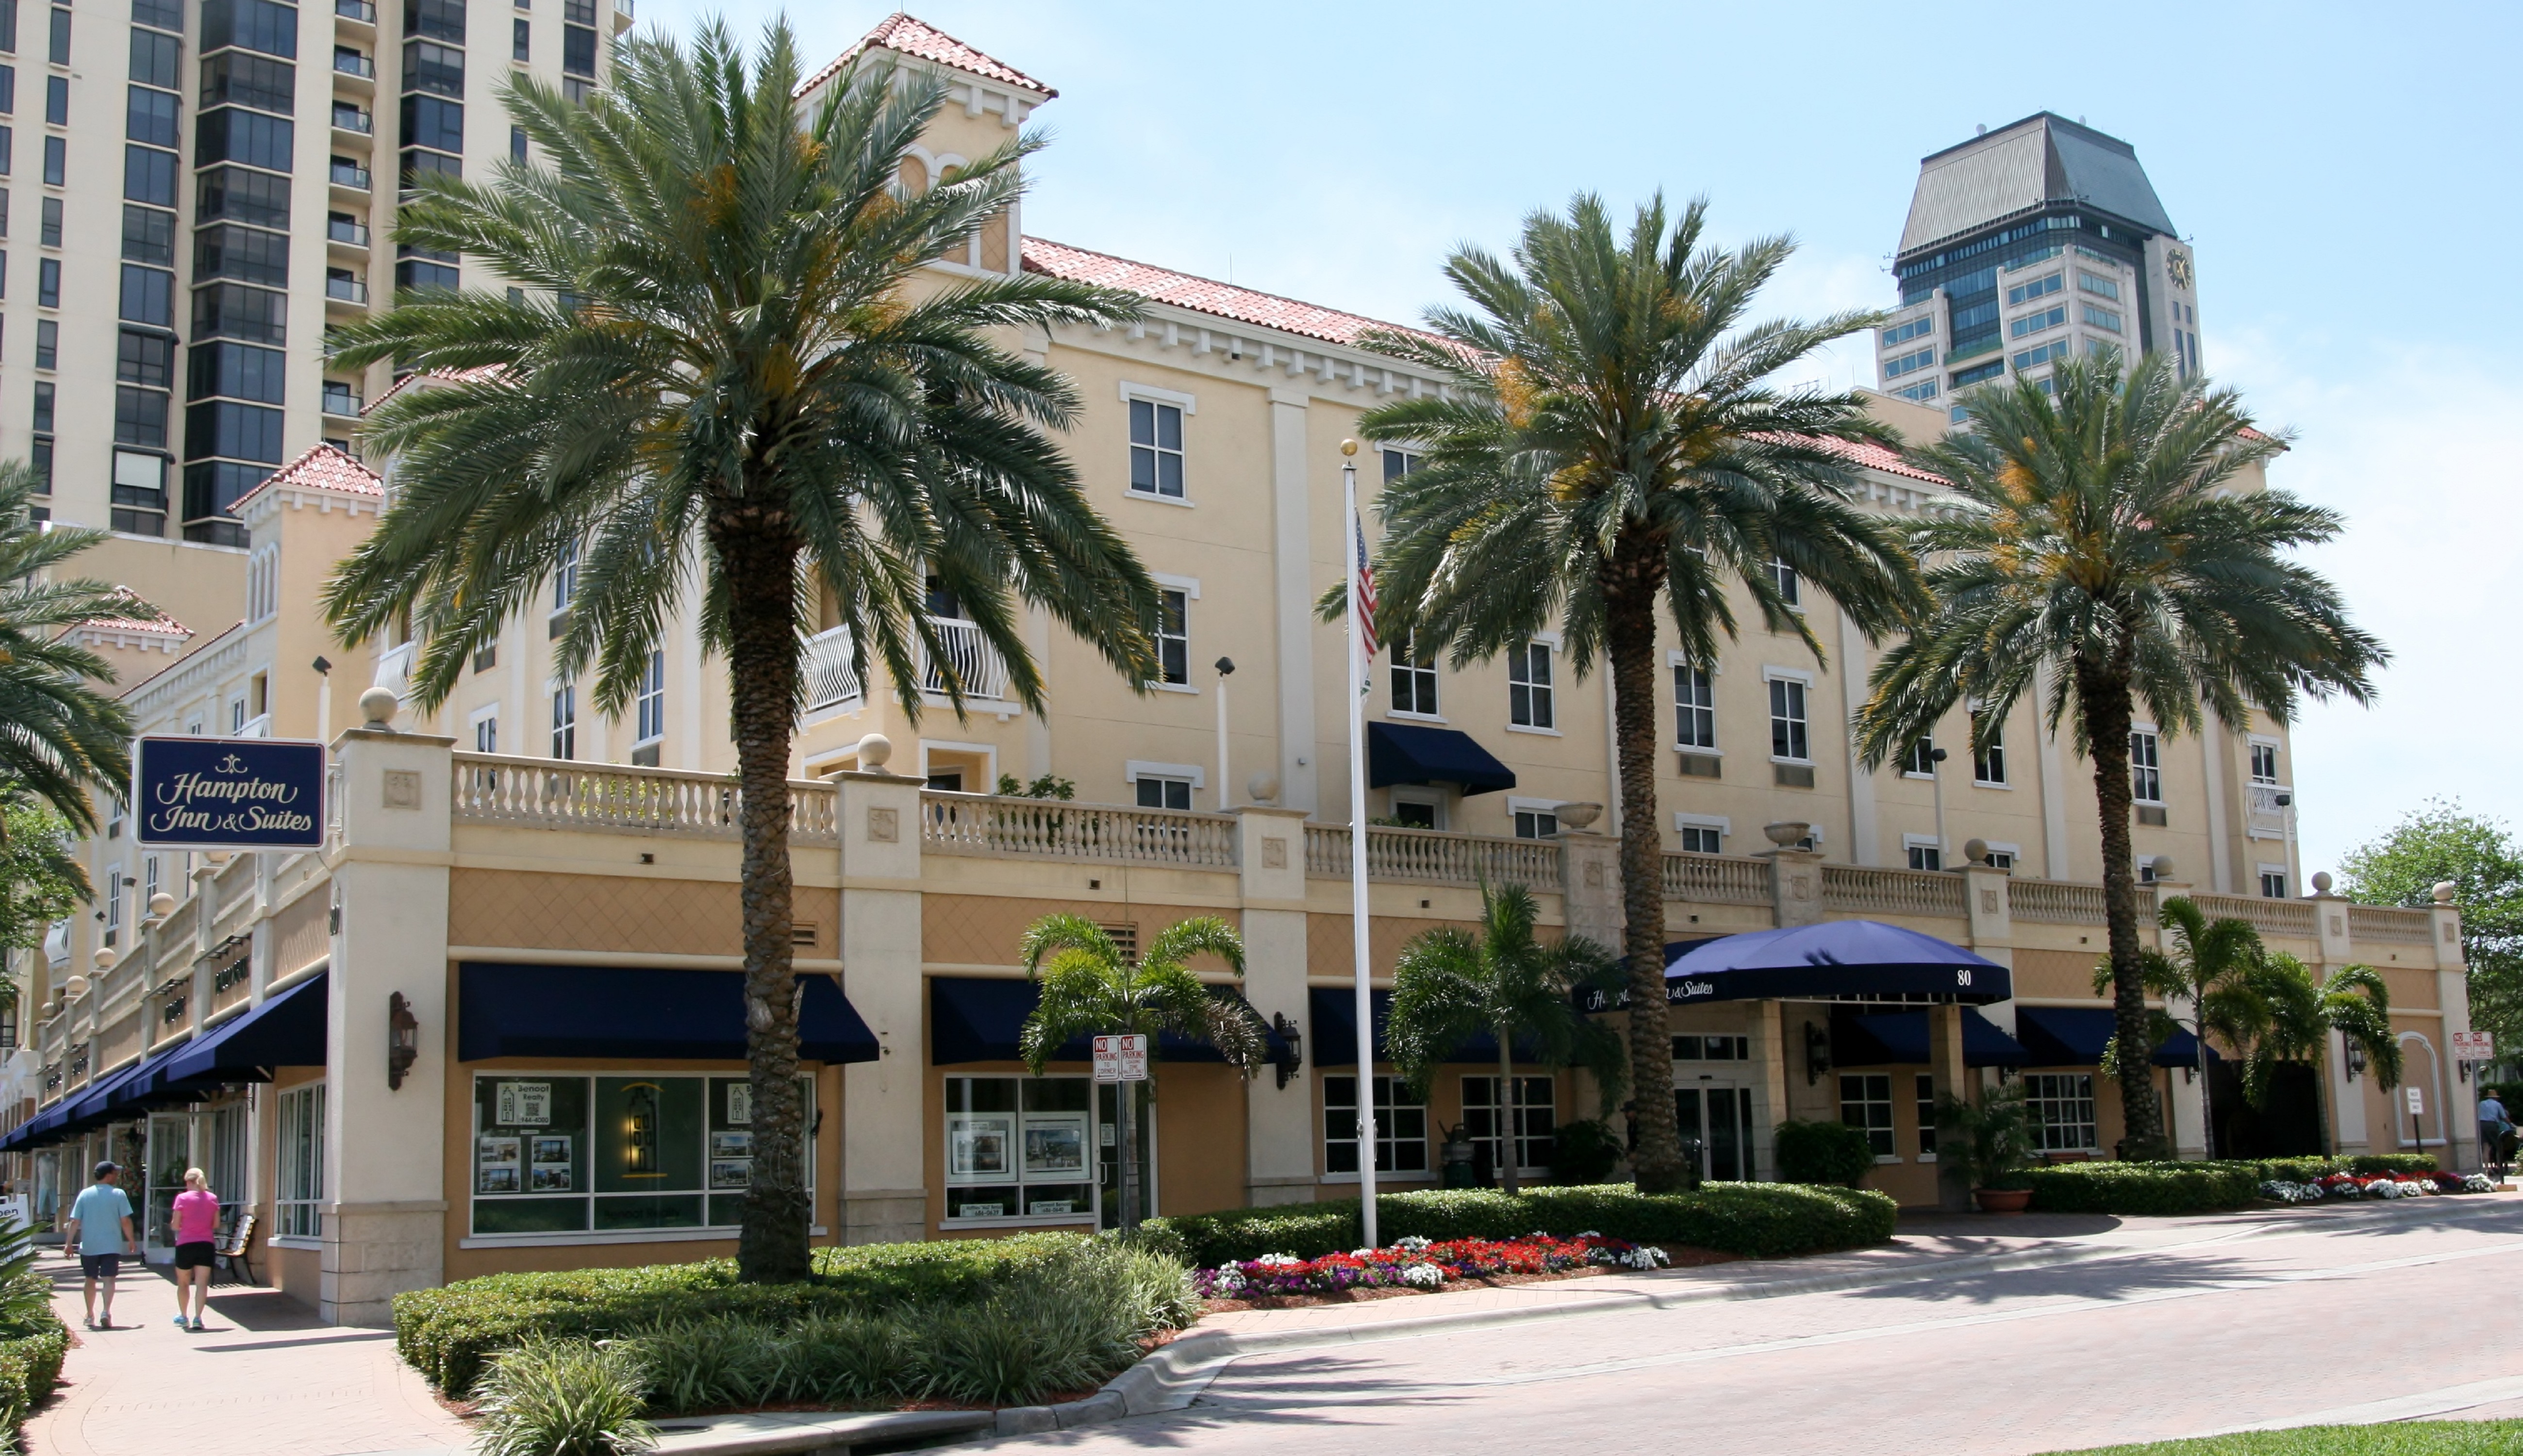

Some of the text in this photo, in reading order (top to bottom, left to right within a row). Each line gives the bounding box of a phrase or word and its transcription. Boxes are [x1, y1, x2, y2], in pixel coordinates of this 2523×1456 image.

[156, 772, 298, 805] Hampton
[150, 805, 312, 832] Inn & Suites
[1957, 970, 1971, 986] 80
[1681, 981, 1713, 997] Suites
[1096, 1039, 1107, 1051] NO
[1122, 1038, 1133, 1049] NO
[1096, 1052, 1117, 1061] PARKING
[1123, 1051, 1144, 1059] PARKING
